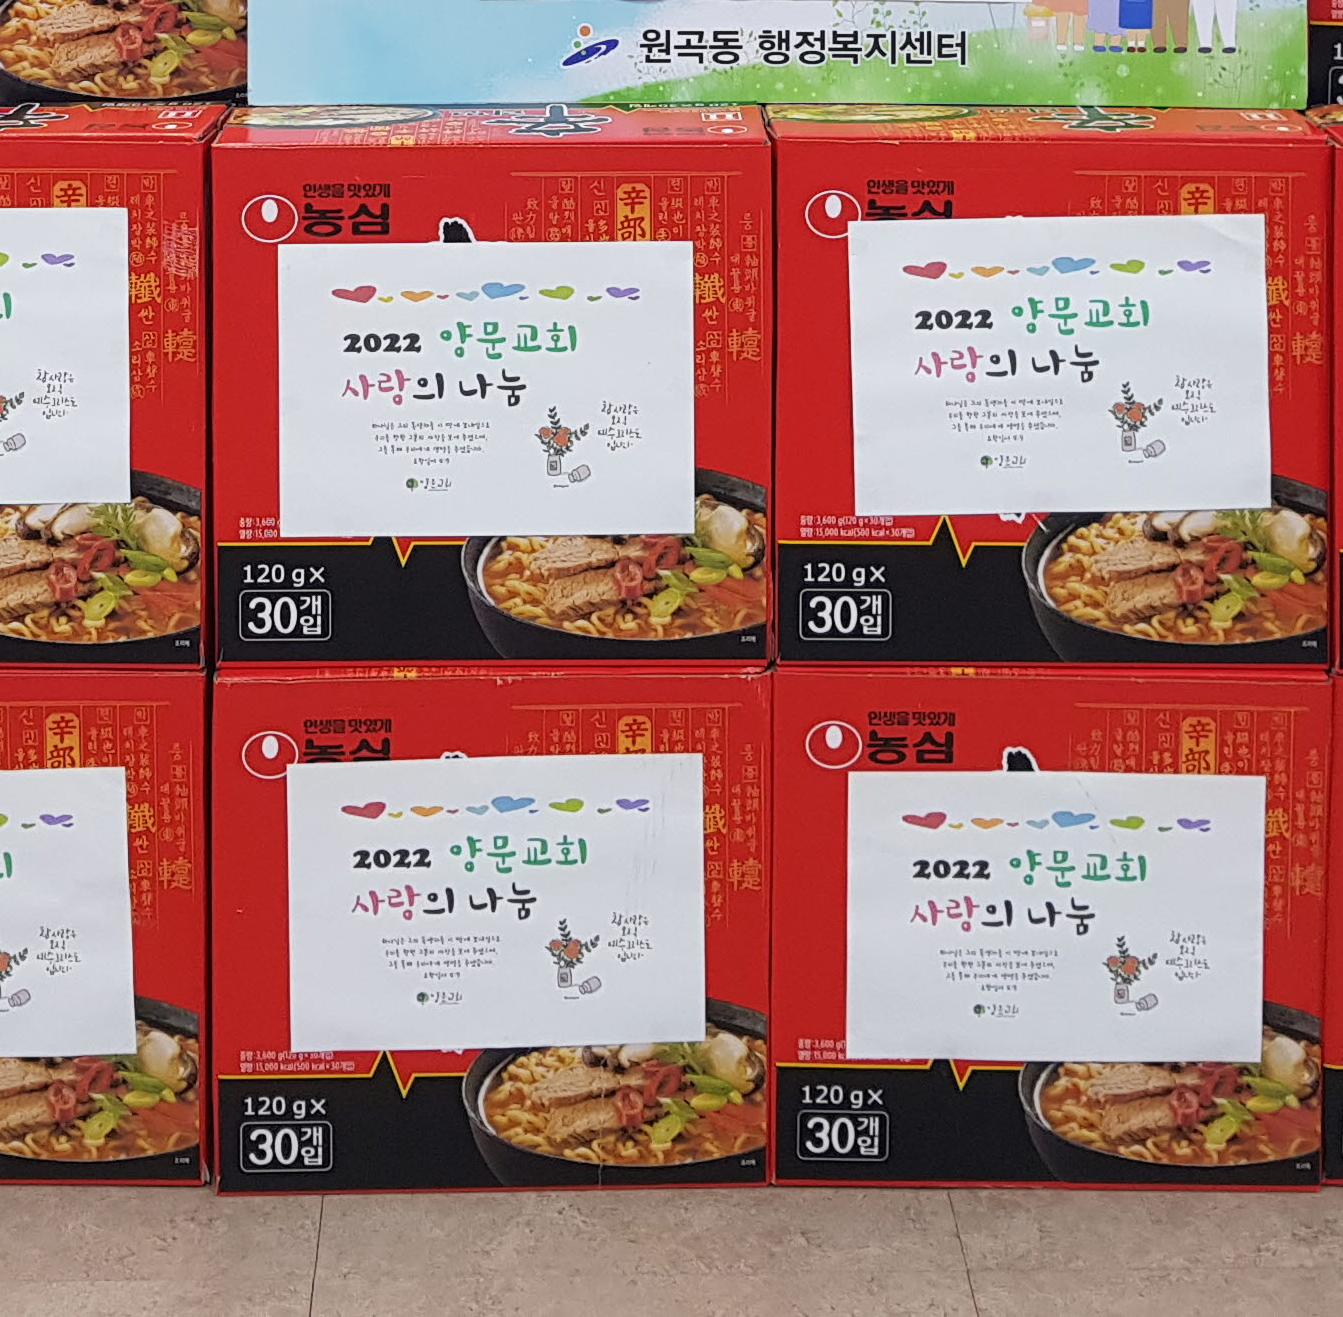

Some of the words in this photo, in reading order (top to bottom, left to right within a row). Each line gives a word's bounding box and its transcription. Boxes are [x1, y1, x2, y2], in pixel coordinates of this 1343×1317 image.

[638, 28, 744, 65] 원곡동
[757, 29, 967, 66] 행정복지센터
[301, 203, 390, 237] 농심
[914, 309, 994, 331] 2022
[1011, 296, 1150, 336] 양문교회
[343, 332, 422, 354] 2022
[439, 321, 578, 360] 양문교회
[914, 345, 1017, 384] 사랑의
[1031, 344, 1100, 384] 나눔
[341, 368, 445, 406] 사랑의
[458, 368, 527, 407] 나눔
[242, 564, 285, 584] 120
[803, 563, 845, 583] 120
[865, 730, 955, 765] 농심
[352, 848, 432, 870] 2022
[449, 834, 588, 874] 양문교회
[912, 859, 991, 881] 2022
[1009, 849, 1147, 889] 양문교회
[351, 884, 455, 921] 사랑의
[468, 881, 538, 921] 나눔
[910, 895, 1013, 933] 사랑의
[1027, 896, 1096, 936] 나눔
[243, 1097, 286, 1117] 120
[801, 1085, 843, 1104] 120
